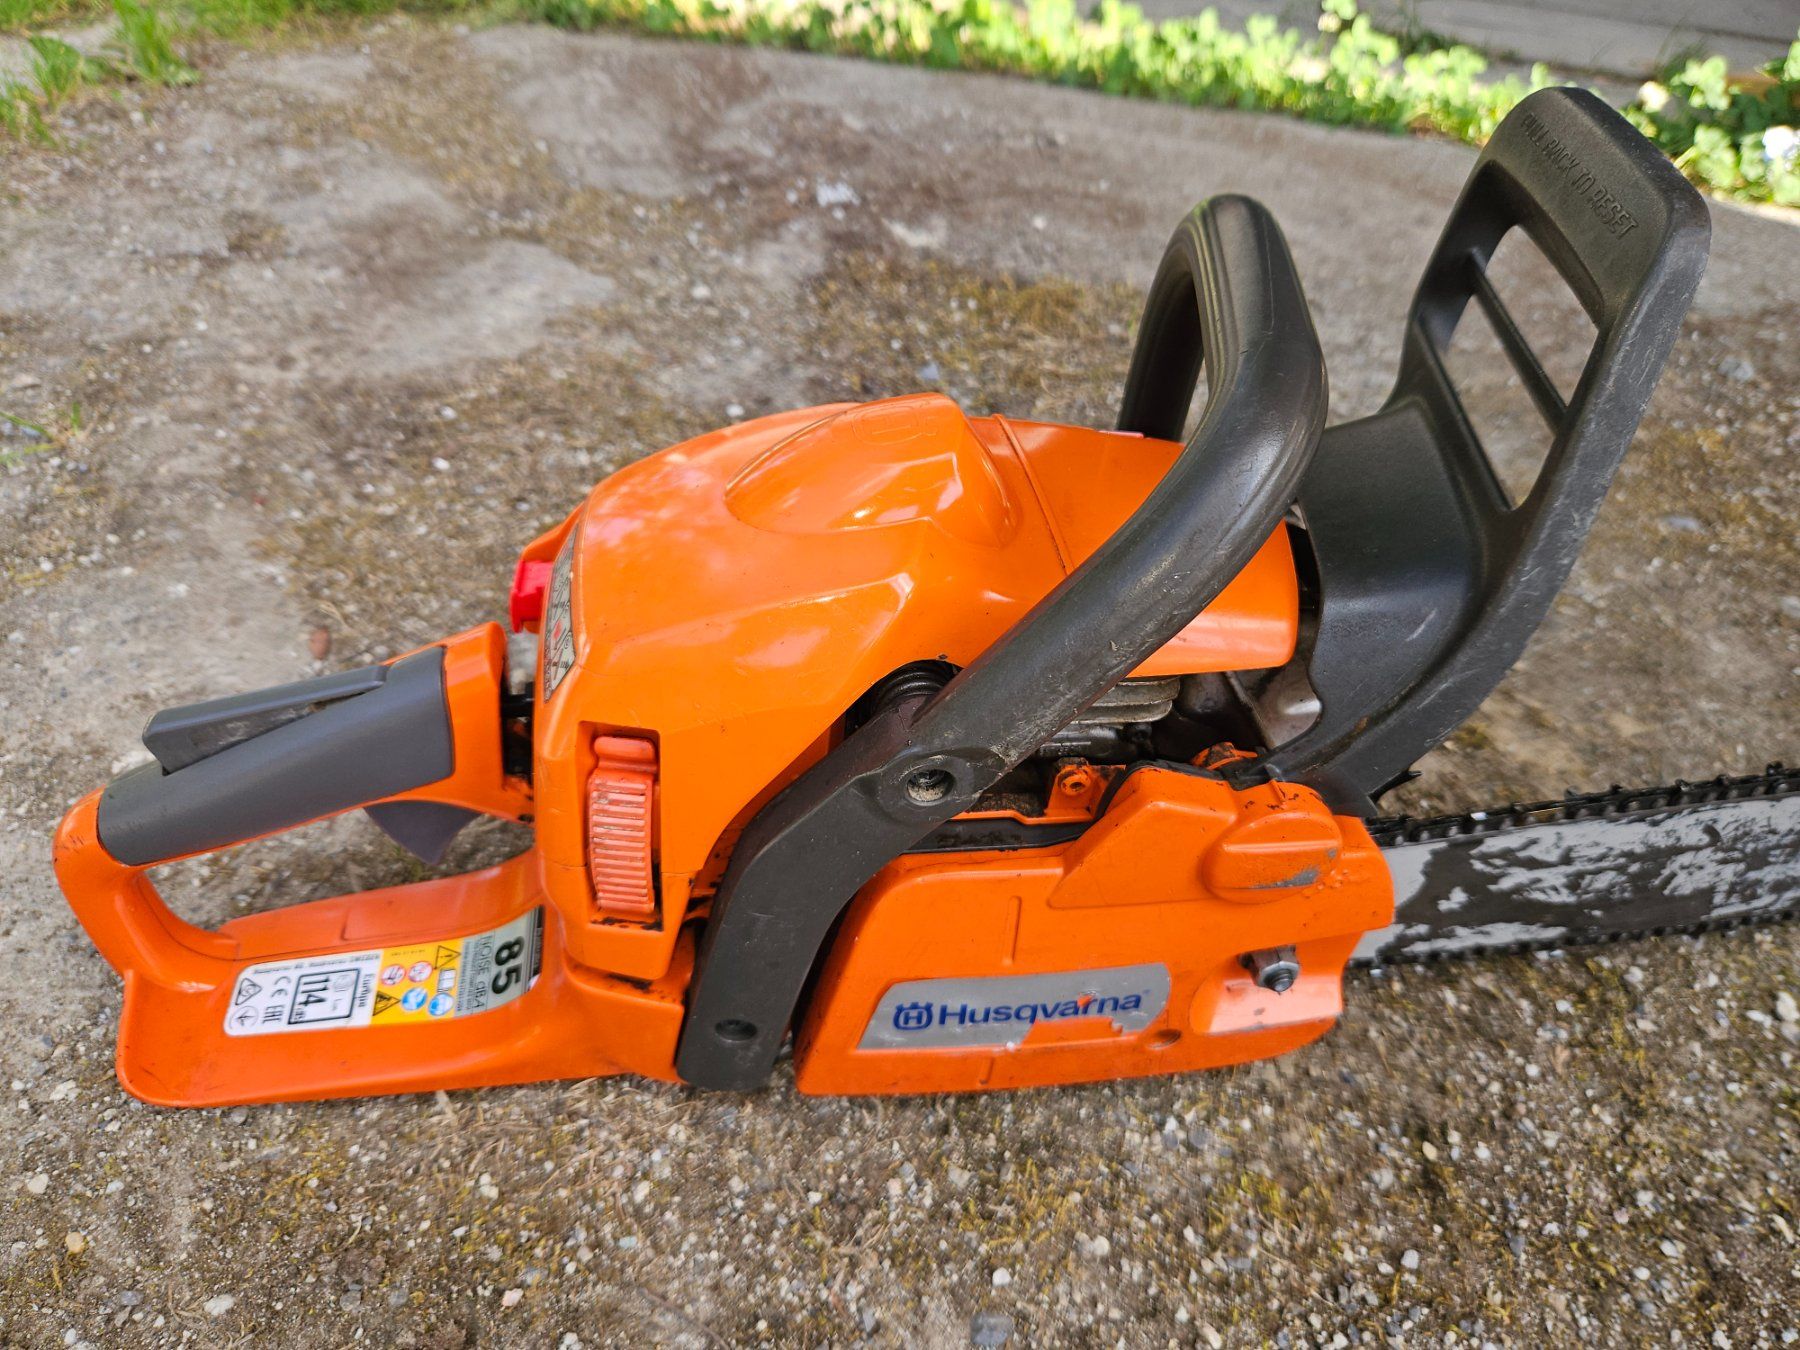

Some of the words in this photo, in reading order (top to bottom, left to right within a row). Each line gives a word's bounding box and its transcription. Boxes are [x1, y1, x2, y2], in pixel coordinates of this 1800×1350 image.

[1544, 138, 1581, 177] BACK
[1572, 169, 1596, 196] TO
[1588, 186, 1639, 240] RESET
[478, 935, 494, 976] NOISE
[491, 936, 525, 994] 85
[298, 975, 331, 1007] 114
[939, 993, 1142, 1026] Husqvarna
